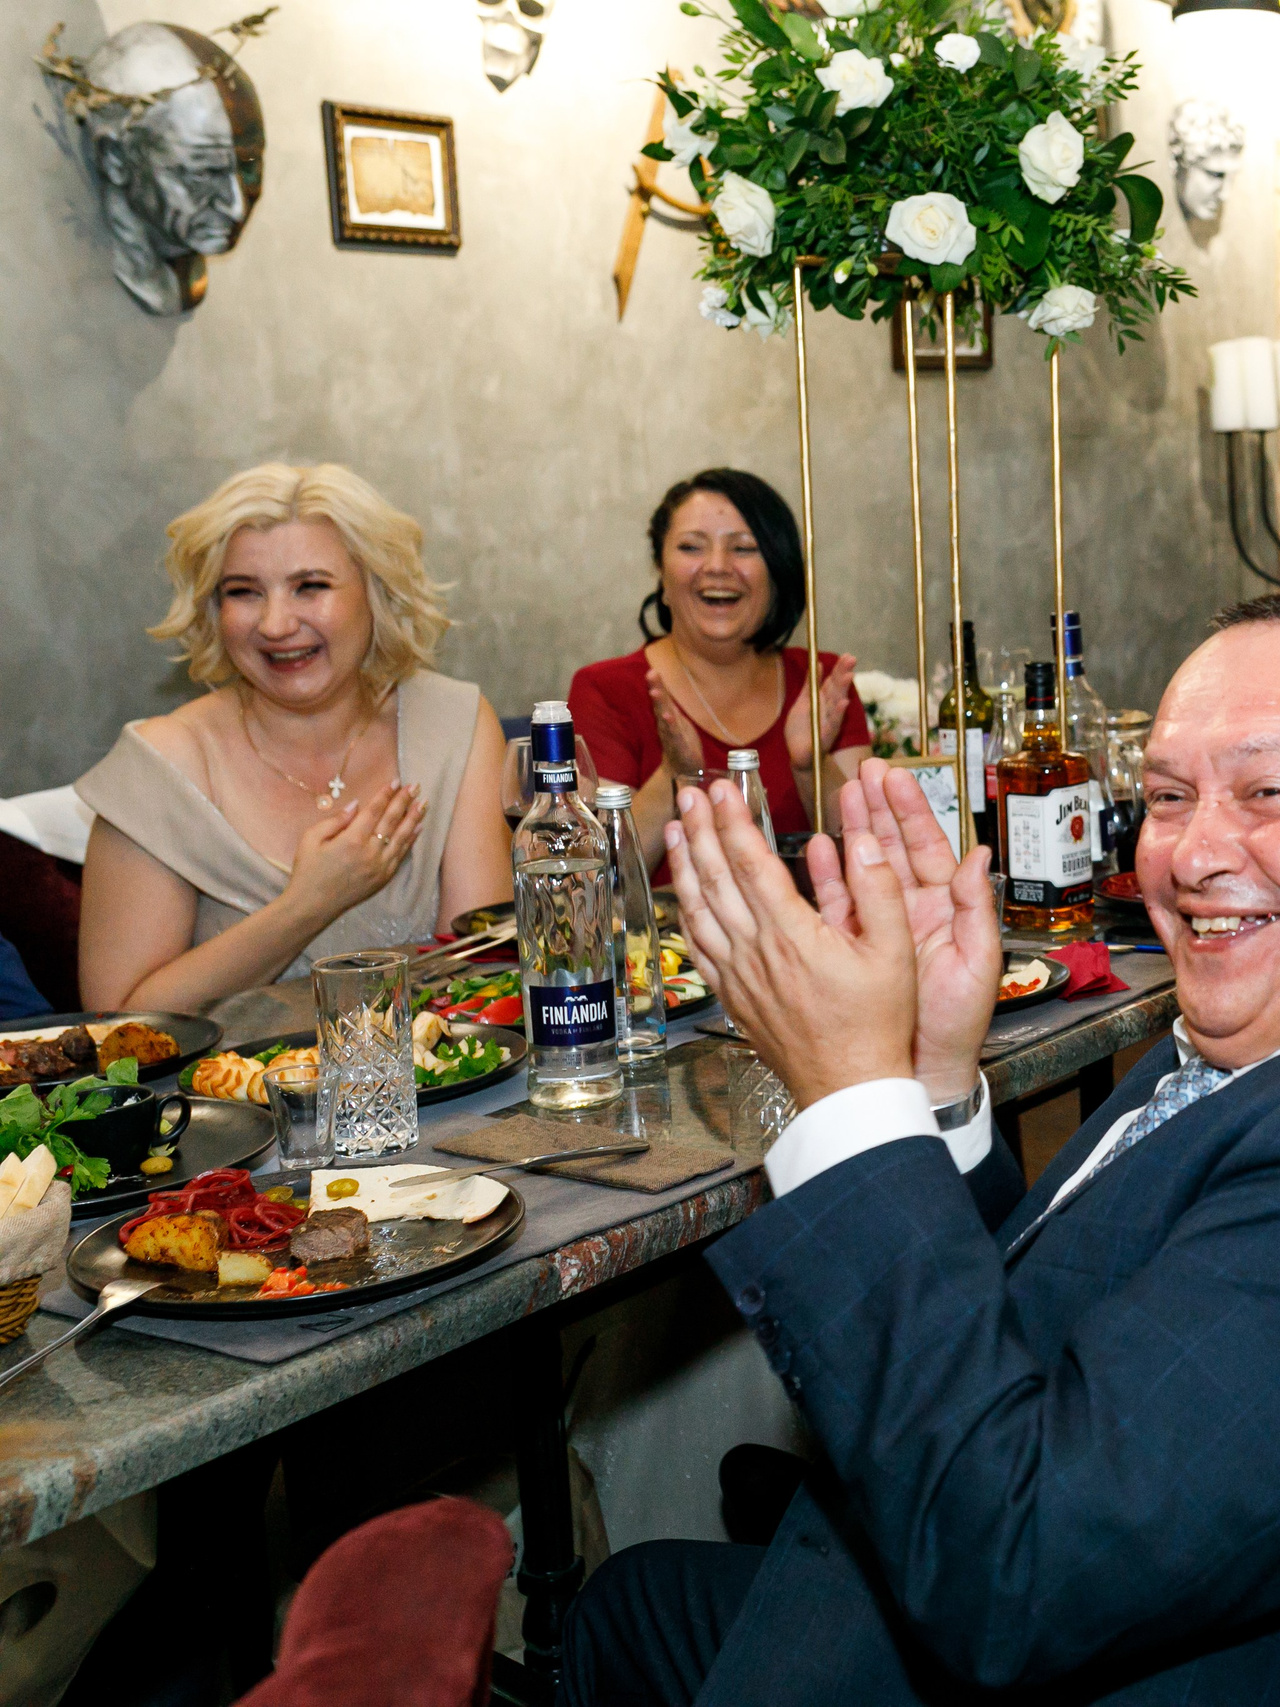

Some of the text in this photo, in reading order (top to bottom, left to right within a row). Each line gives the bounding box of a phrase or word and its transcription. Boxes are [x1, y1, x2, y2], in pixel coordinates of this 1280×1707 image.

[542, 772, 573, 783] FINLANDIA
[1056, 800, 1072, 825] JIM
[542, 1000, 608, 1025] FINLANDIA
